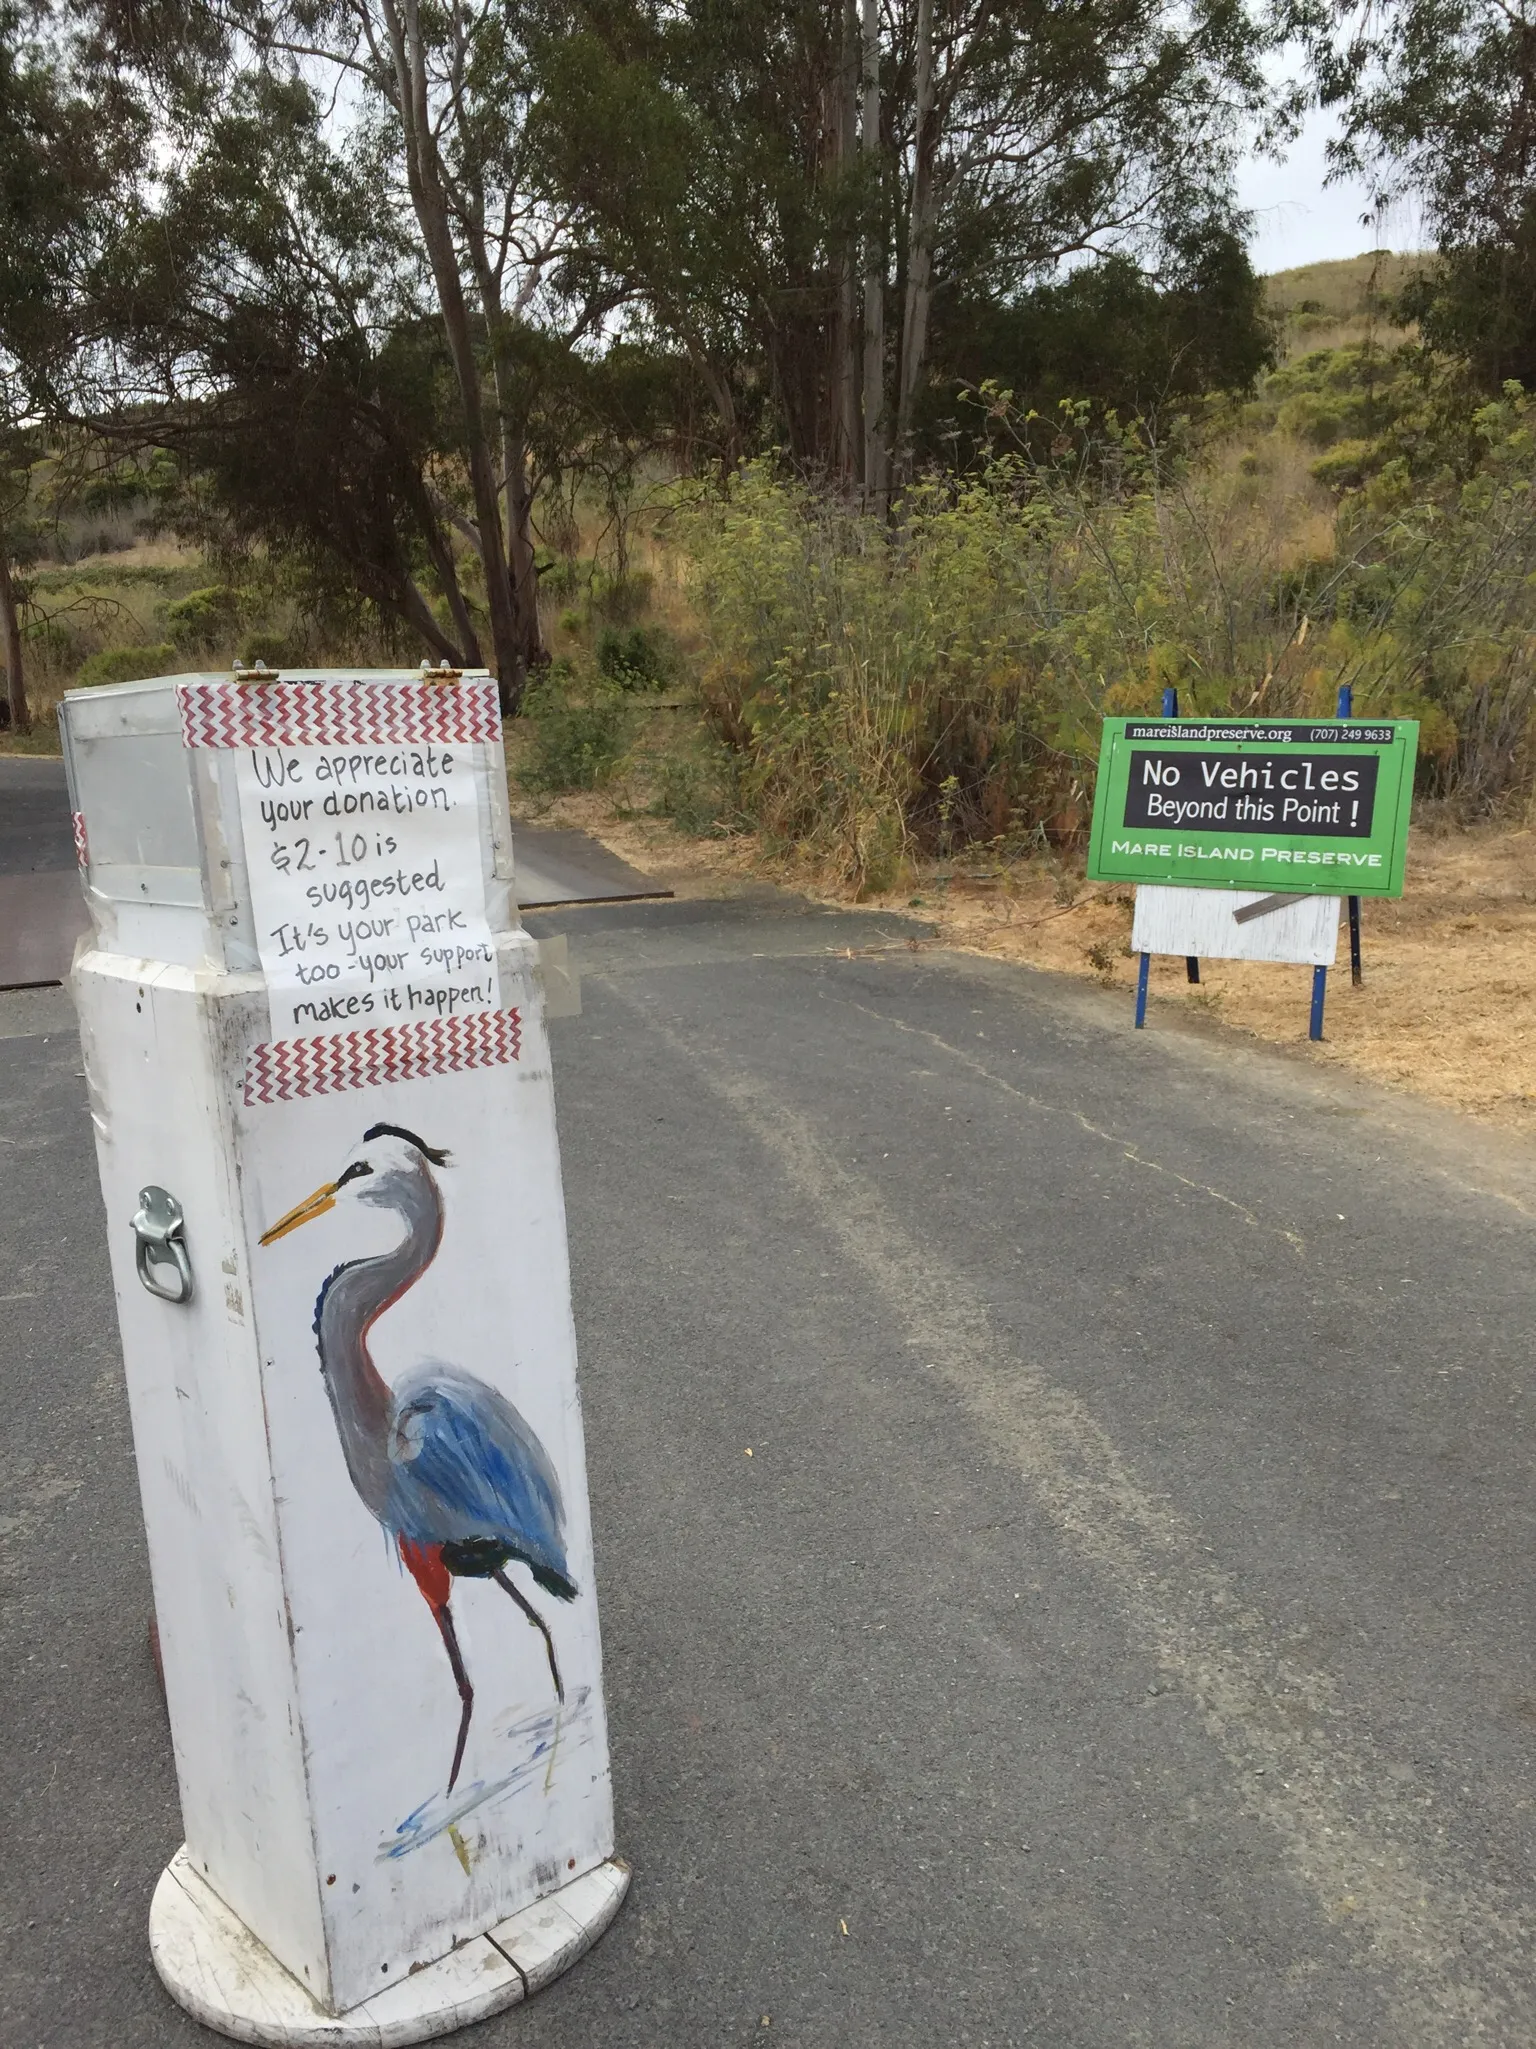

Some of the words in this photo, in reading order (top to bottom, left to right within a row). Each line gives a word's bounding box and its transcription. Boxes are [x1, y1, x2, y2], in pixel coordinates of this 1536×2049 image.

[1132, 725, 1293, 742] mareislandpreserve.org
[1309, 729, 1338, 742] (707)
[1341, 729, 1362, 740] 249
[1364, 730, 1392, 741] 9633
[252, 749, 303, 788] We
[315, 746, 454, 786] appreciate
[1142, 760, 1181, 787] No
[1201, 761, 1360, 791] Vehicles
[260, 798, 314, 831] your
[1147, 794, 1228, 824] Beyond
[1235, 795, 1274, 821] this
[376, 832, 398, 856] is
[1111, 840, 1171, 857] MARE
[1178, 844, 1255, 861] ISLAND
[1261, 848, 1382, 867] PRESERVE
[306, 859, 446, 910] suggested
[270, 923, 329, 957] It's
[338, 918, 394, 956] your
[406, 908, 467, 943] park
[420, 942, 493, 974] support
[293, 993, 375, 1024] makes
[384, 988, 401, 1011] it
[407, 978, 492, 1015] happen!
